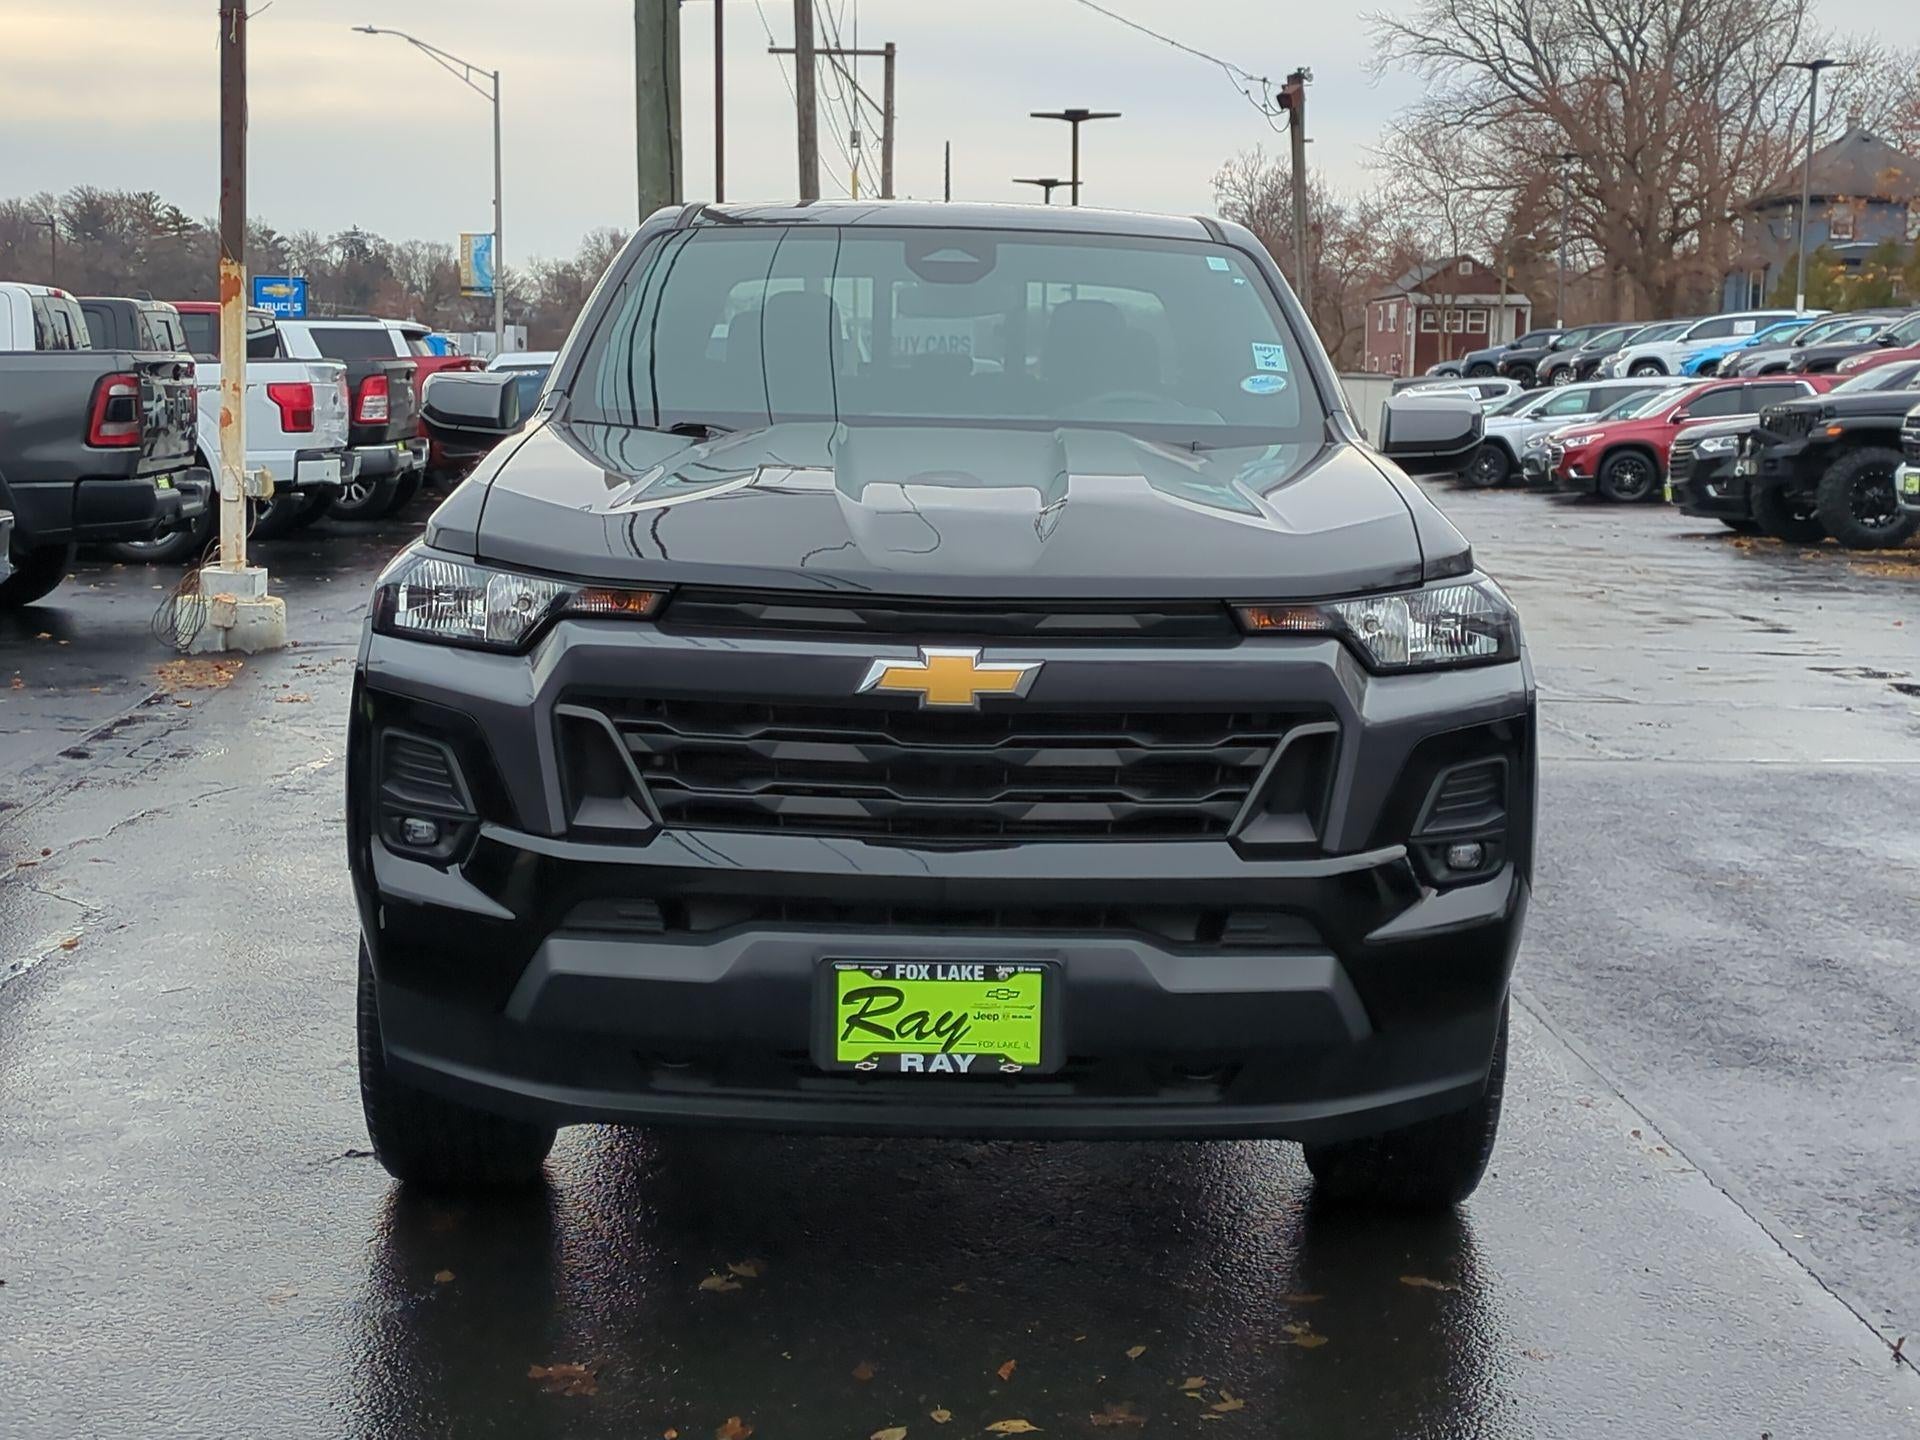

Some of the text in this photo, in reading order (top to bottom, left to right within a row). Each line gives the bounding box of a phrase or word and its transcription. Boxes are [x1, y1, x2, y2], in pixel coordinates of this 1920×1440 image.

[925, 335, 971, 352] CARS
[895, 964, 984, 981] FOX LAKE
[840, 985, 972, 1053] Ray
[973, 1011, 1000, 1022] Jeep
[978, 1041, 995, 1049] FOX
[900, 1053, 977, 1073] RAY
